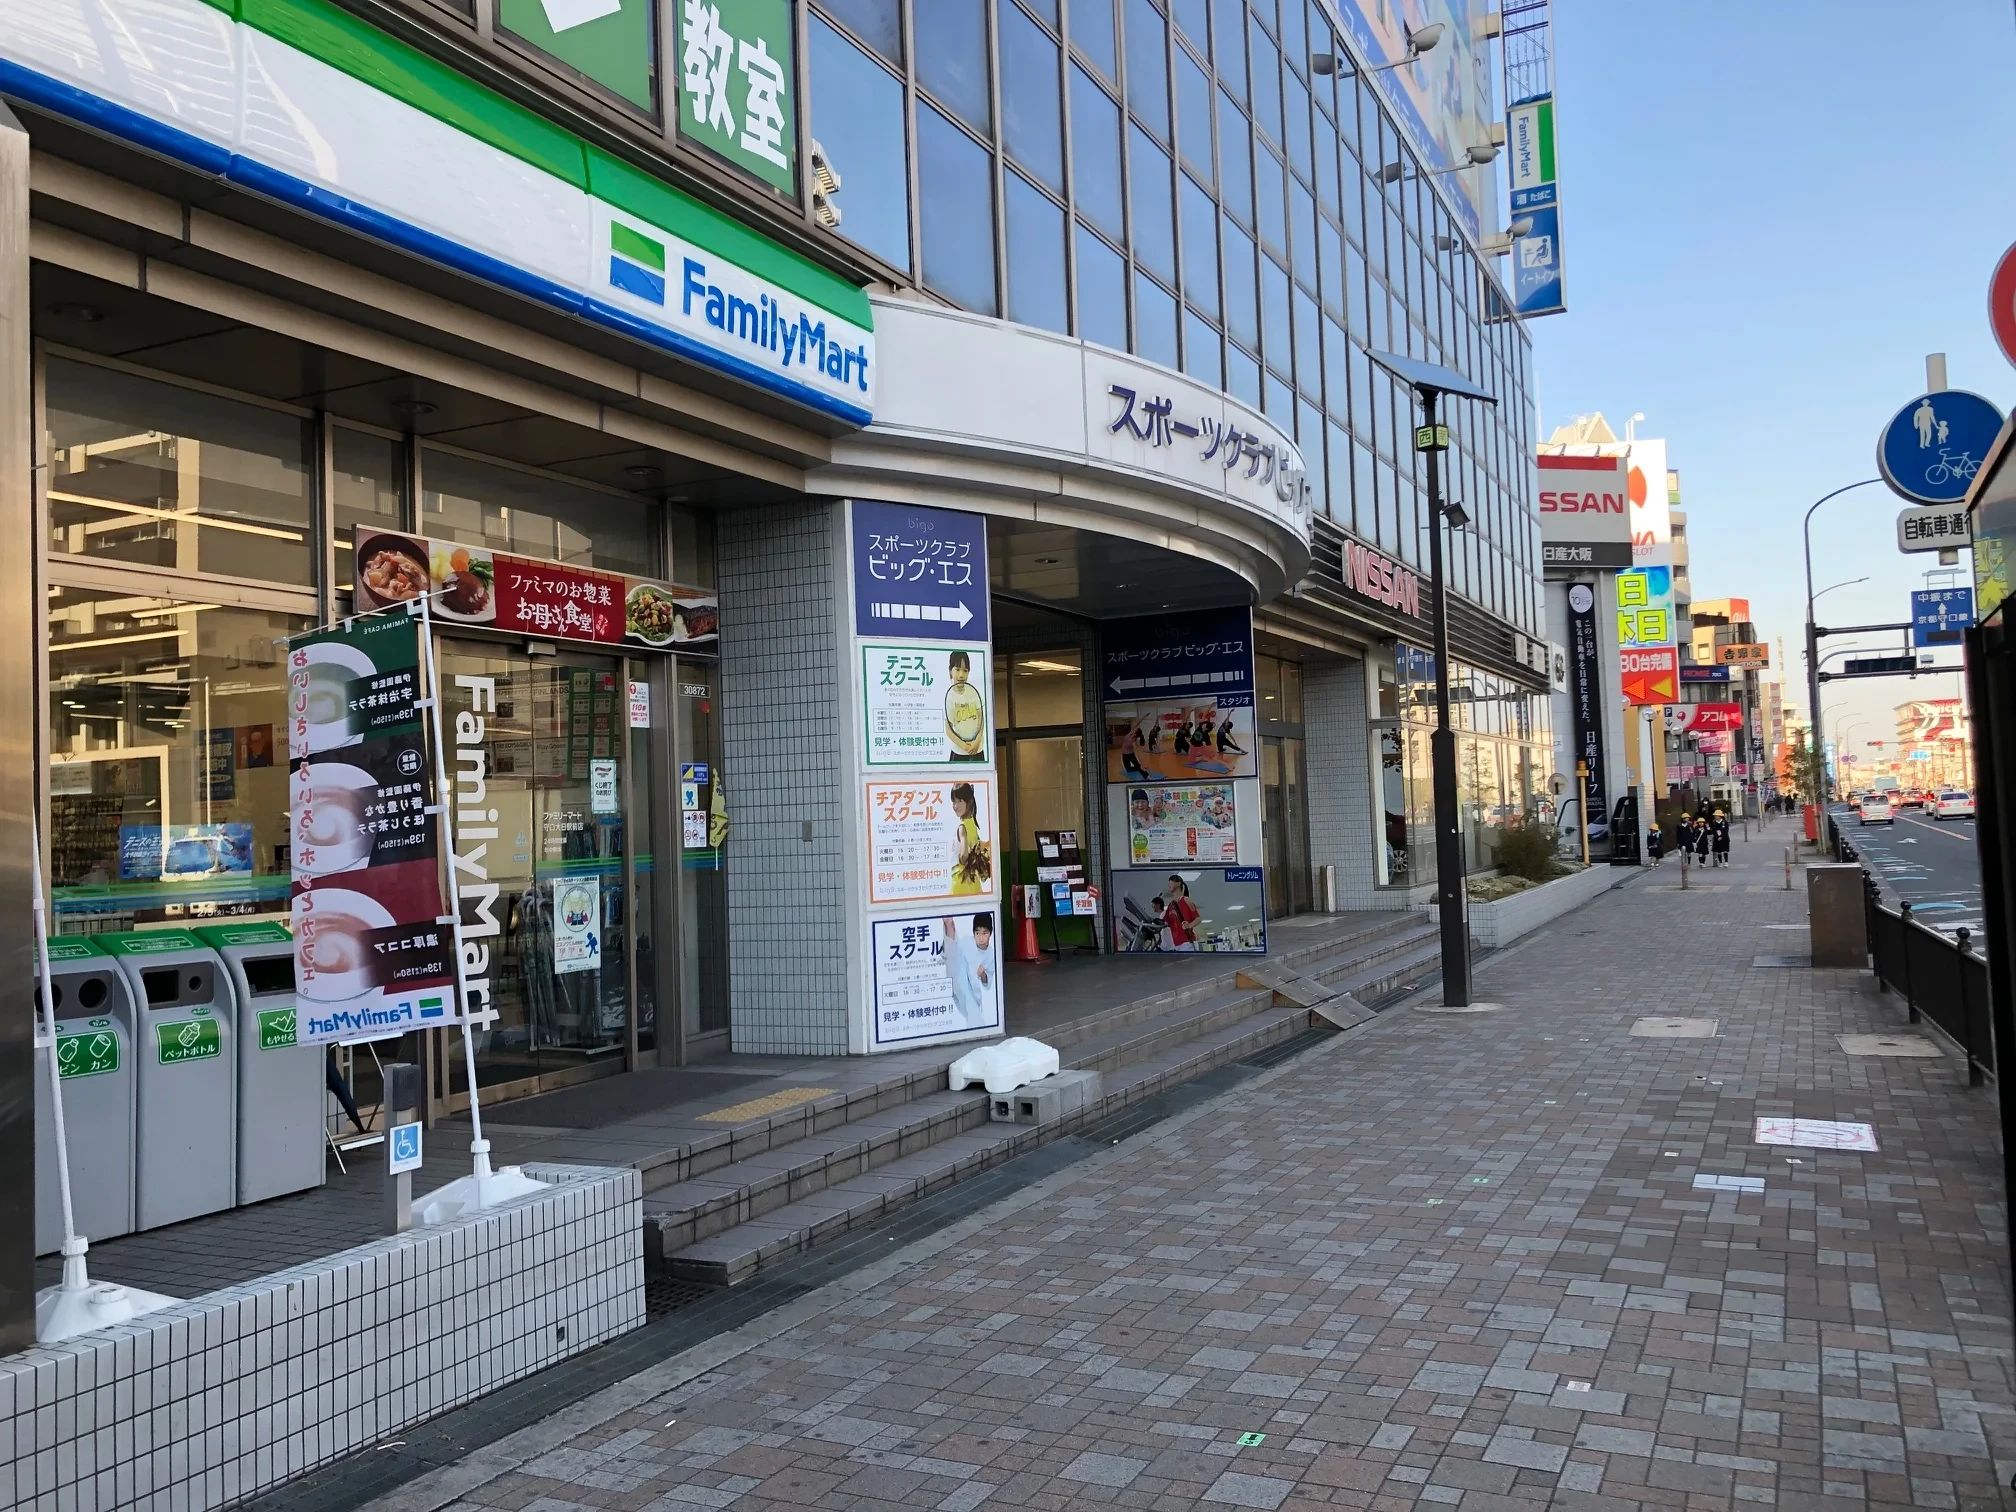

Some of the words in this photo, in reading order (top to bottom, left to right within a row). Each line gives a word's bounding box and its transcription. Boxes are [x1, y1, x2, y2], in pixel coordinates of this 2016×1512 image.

[682, 0, 788, 171] 教室
[1519, 116, 1532, 178] FamilyMart
[683, 257, 869, 391] FamilyMart
[1539, 492, 1624, 513] SSAN
[869, 534, 971, 558] スポーツクラブ
[1543, 547, 1592, 561] 日産大阪
[869, 554, 972, 586] ビッグ・エス
[1341, 539, 1420, 619] NISSAN
[511, 574, 612, 606] ファミマのお惣菜
[516, 597, 593, 632] お母さん食堂
[886, 655, 926, 670] テニス
[880, 671, 933, 686] スクール
[684, 685, 706, 696] 30872
[1219, 697, 1251, 706] スタジオ
[1701, 711, 1726, 722] アコム
[1586, 731, 1598, 794] 日産リーフ
[876, 790, 943, 806] チアダンス
[544, 811, 582, 820] ファミリーマート
[884, 806, 938, 821] スクール
[453, 674, 501, 1032] FamilyMart
[1227, 871, 1259, 879] トレーニングジム
[902, 925, 930, 943] 空手
[890, 941, 944, 960] スクール
[267, 1034, 297, 1045] もやせる
[165, 1044, 216, 1059] ペットボトル
[90, 1058, 112, 1070] カン
